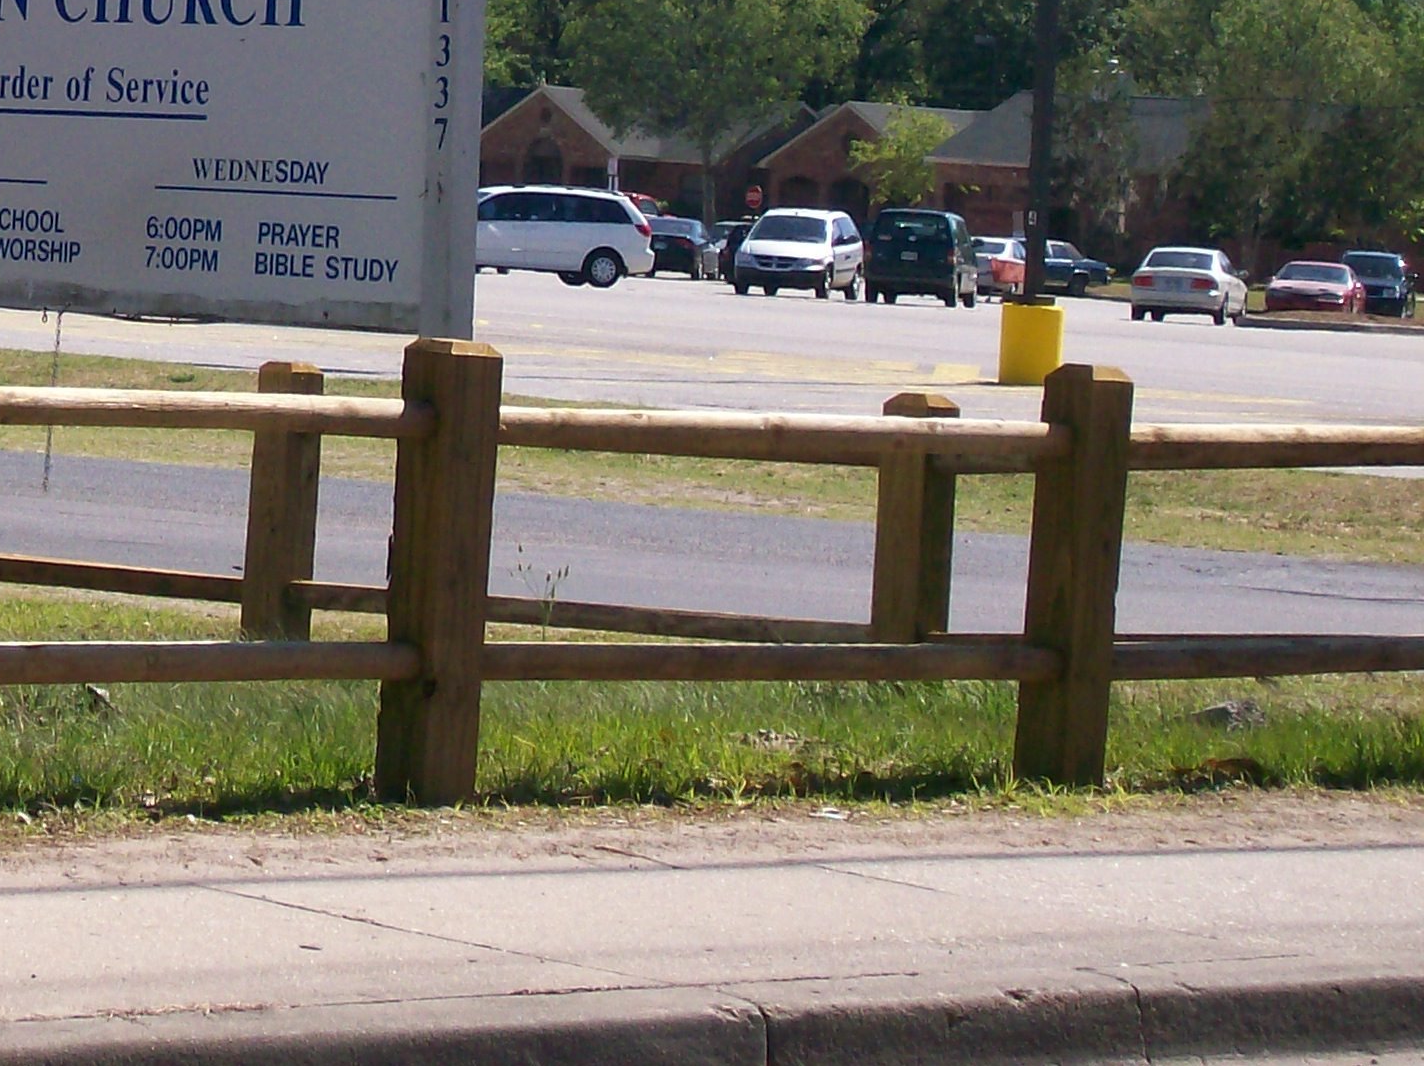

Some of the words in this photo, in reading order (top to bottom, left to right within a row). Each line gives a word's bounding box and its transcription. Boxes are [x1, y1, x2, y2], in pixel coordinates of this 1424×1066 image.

[66, 66, 95, 102] of
[106, 66, 210, 105] Service
[193, 157, 329, 184] WEDNESDAY
[146, 216, 222, 243] 6:00PM
[258, 221, 340, 249] PRAYER
[144, 246, 218, 272] 7:00PM
[255, 252, 315, 278] BIBLE
[325, 256, 399, 283] STUDY
